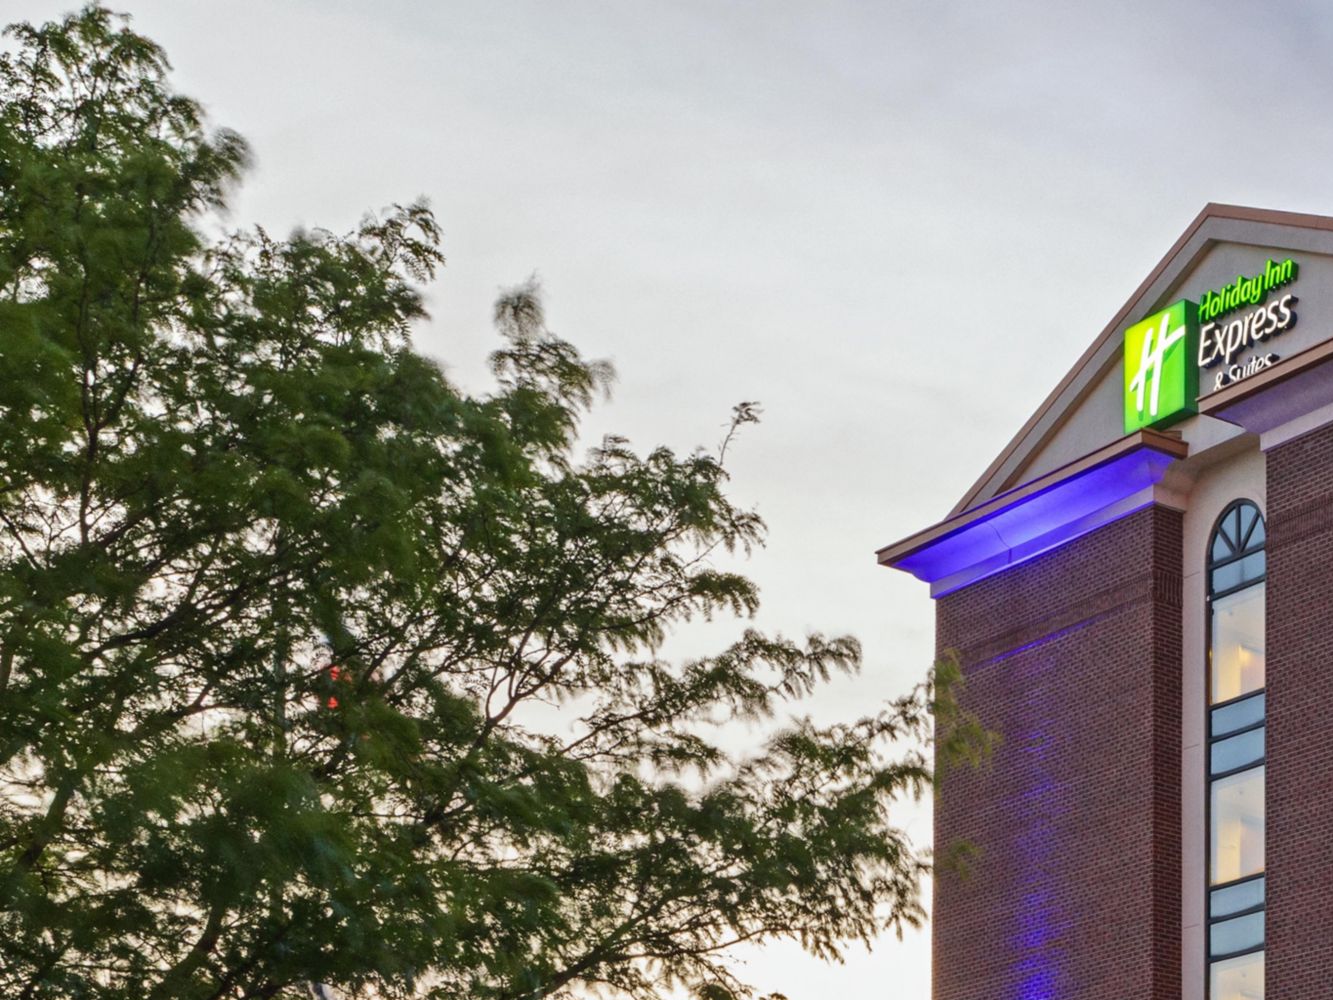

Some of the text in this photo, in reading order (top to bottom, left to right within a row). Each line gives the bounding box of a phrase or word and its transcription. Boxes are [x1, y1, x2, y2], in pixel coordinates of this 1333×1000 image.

[1198, 258, 1293, 321] Holiday Inn
[1198, 294, 1292, 367] Express
[1228, 352, 1273, 382] Suites
